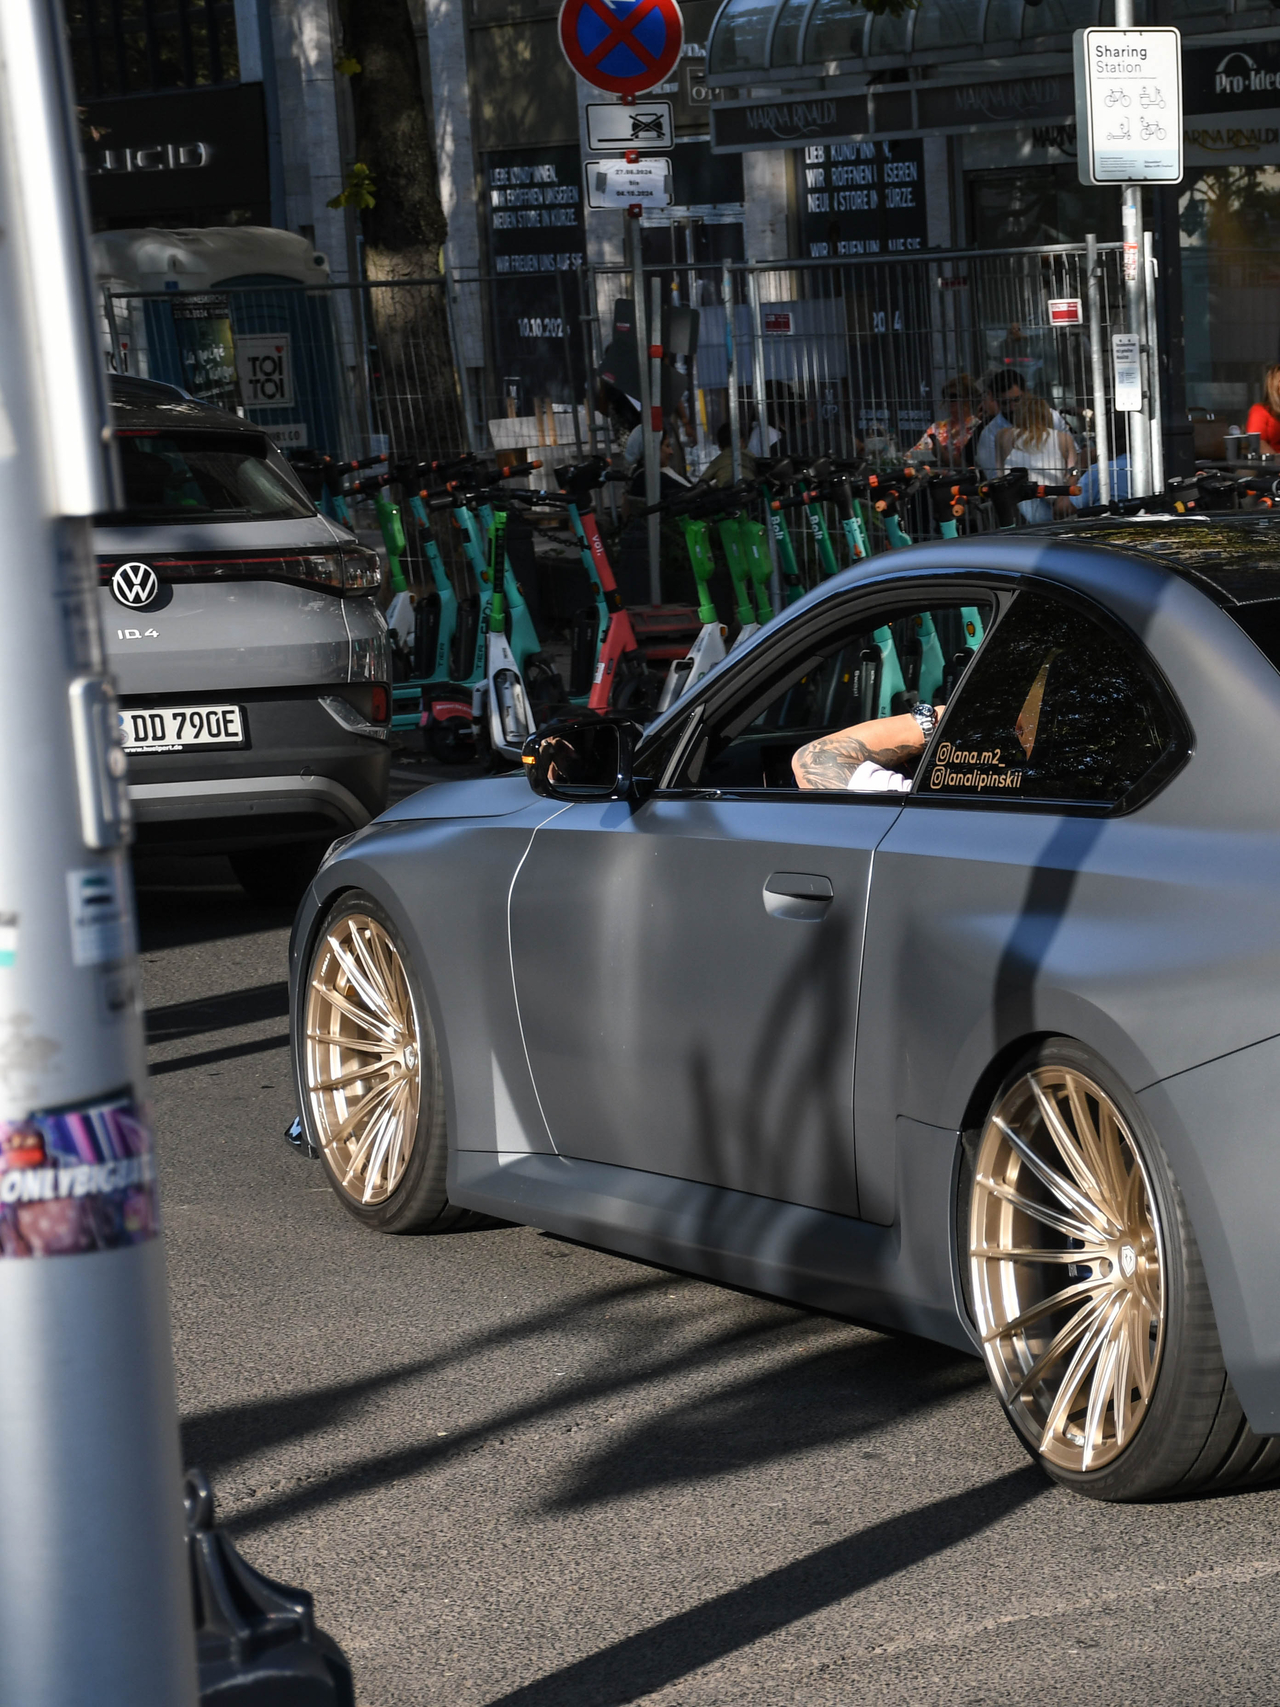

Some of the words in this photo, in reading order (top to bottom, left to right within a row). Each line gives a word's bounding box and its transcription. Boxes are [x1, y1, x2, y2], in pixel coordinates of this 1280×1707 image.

[1095, 45, 1147, 60] Sharing
[1096, 60, 1142, 73] Station
[746, 103, 791, 131] MARINA
[792, 101, 838, 128] RINALDI
[1184, 130, 1228, 150] ARINA
[1228, 127, 1280, 149] RINALDI
[805, 145, 825, 164] LIEB
[806, 168, 825, 188] WIR
[831, 165, 872, 187] RÖFFNEN
[491, 190, 506, 208] WIR
[840, 190, 869, 211] STORE
[493, 211, 517, 229] NEUEN
[518, 210, 541, 228] STORE
[542, 209, 551, 227] IN
[496, 255, 511, 273] WIR
[539, 254, 555, 271] UNS
[771, 516, 784, 539] Bolt
[810, 515, 823, 539] Bolt
[476, 644, 484, 670] TIER
[131, 713, 166, 742] DD
[172, 709, 239, 740] 790E
[944, 770, 1023, 791] lanalipinskii
